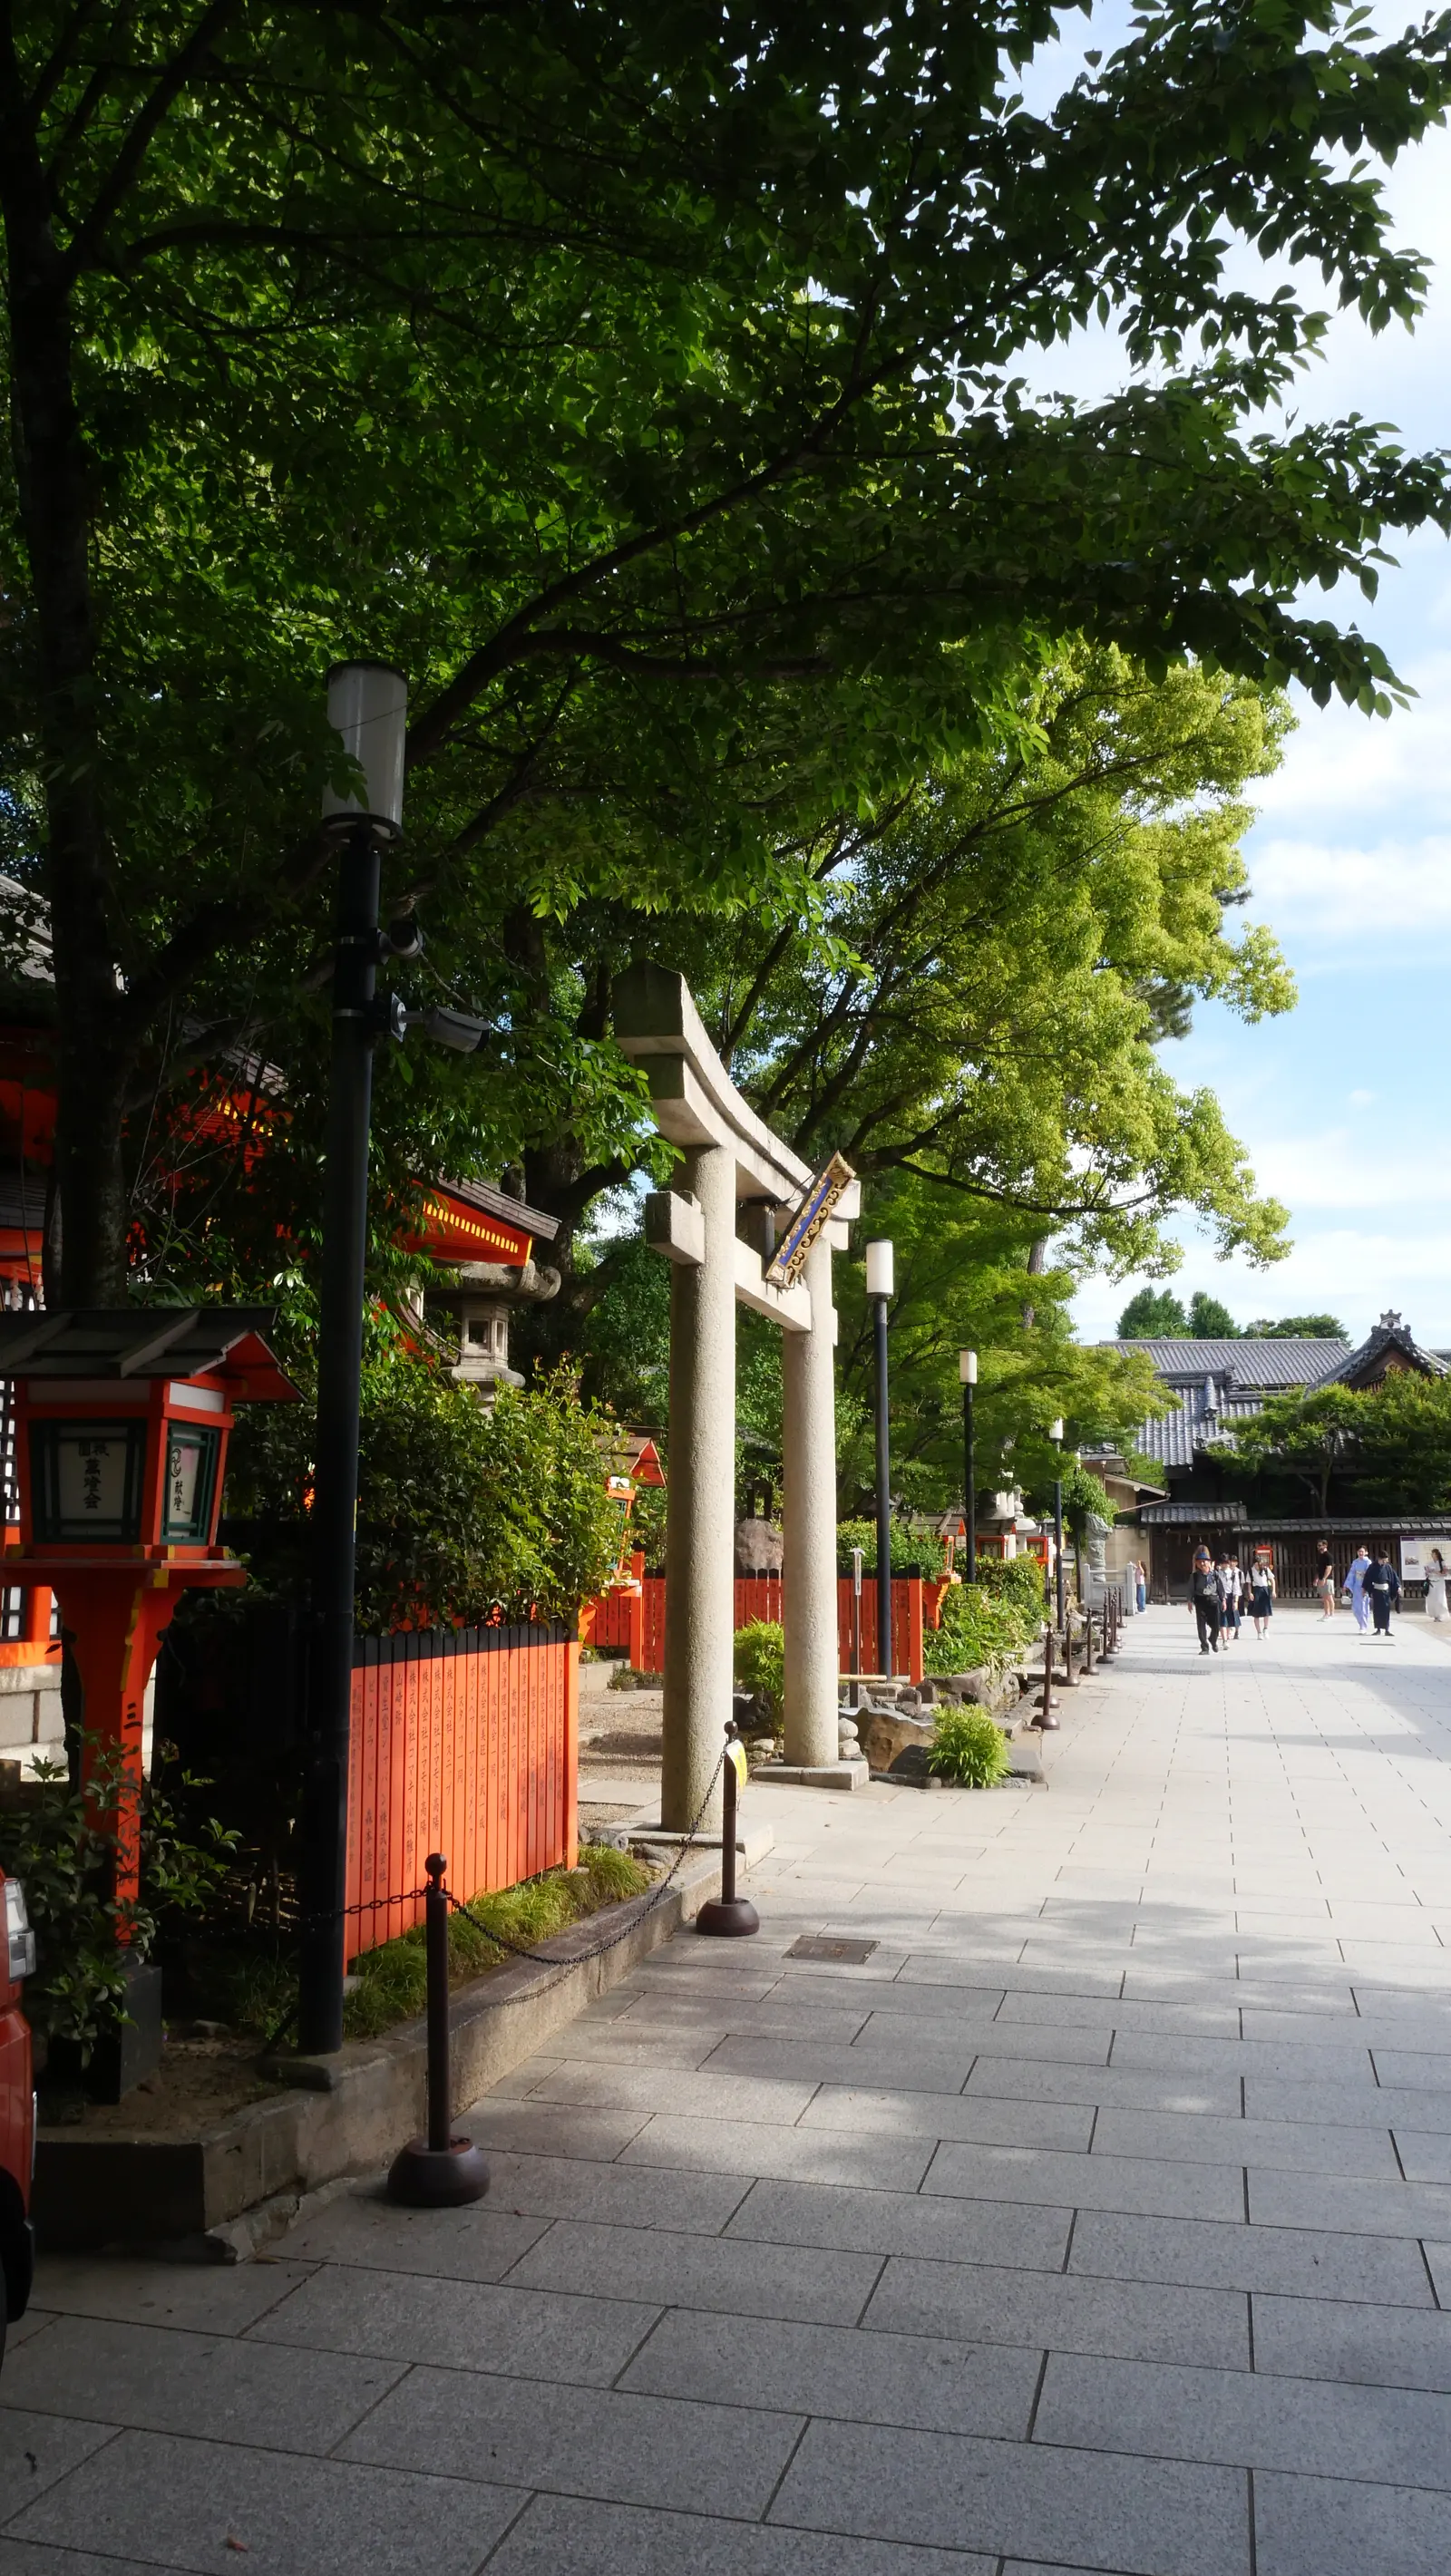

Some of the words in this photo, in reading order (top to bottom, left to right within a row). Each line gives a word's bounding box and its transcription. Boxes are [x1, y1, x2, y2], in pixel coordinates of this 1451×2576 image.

[456, 1695, 464, 1784] スタッフ一同
